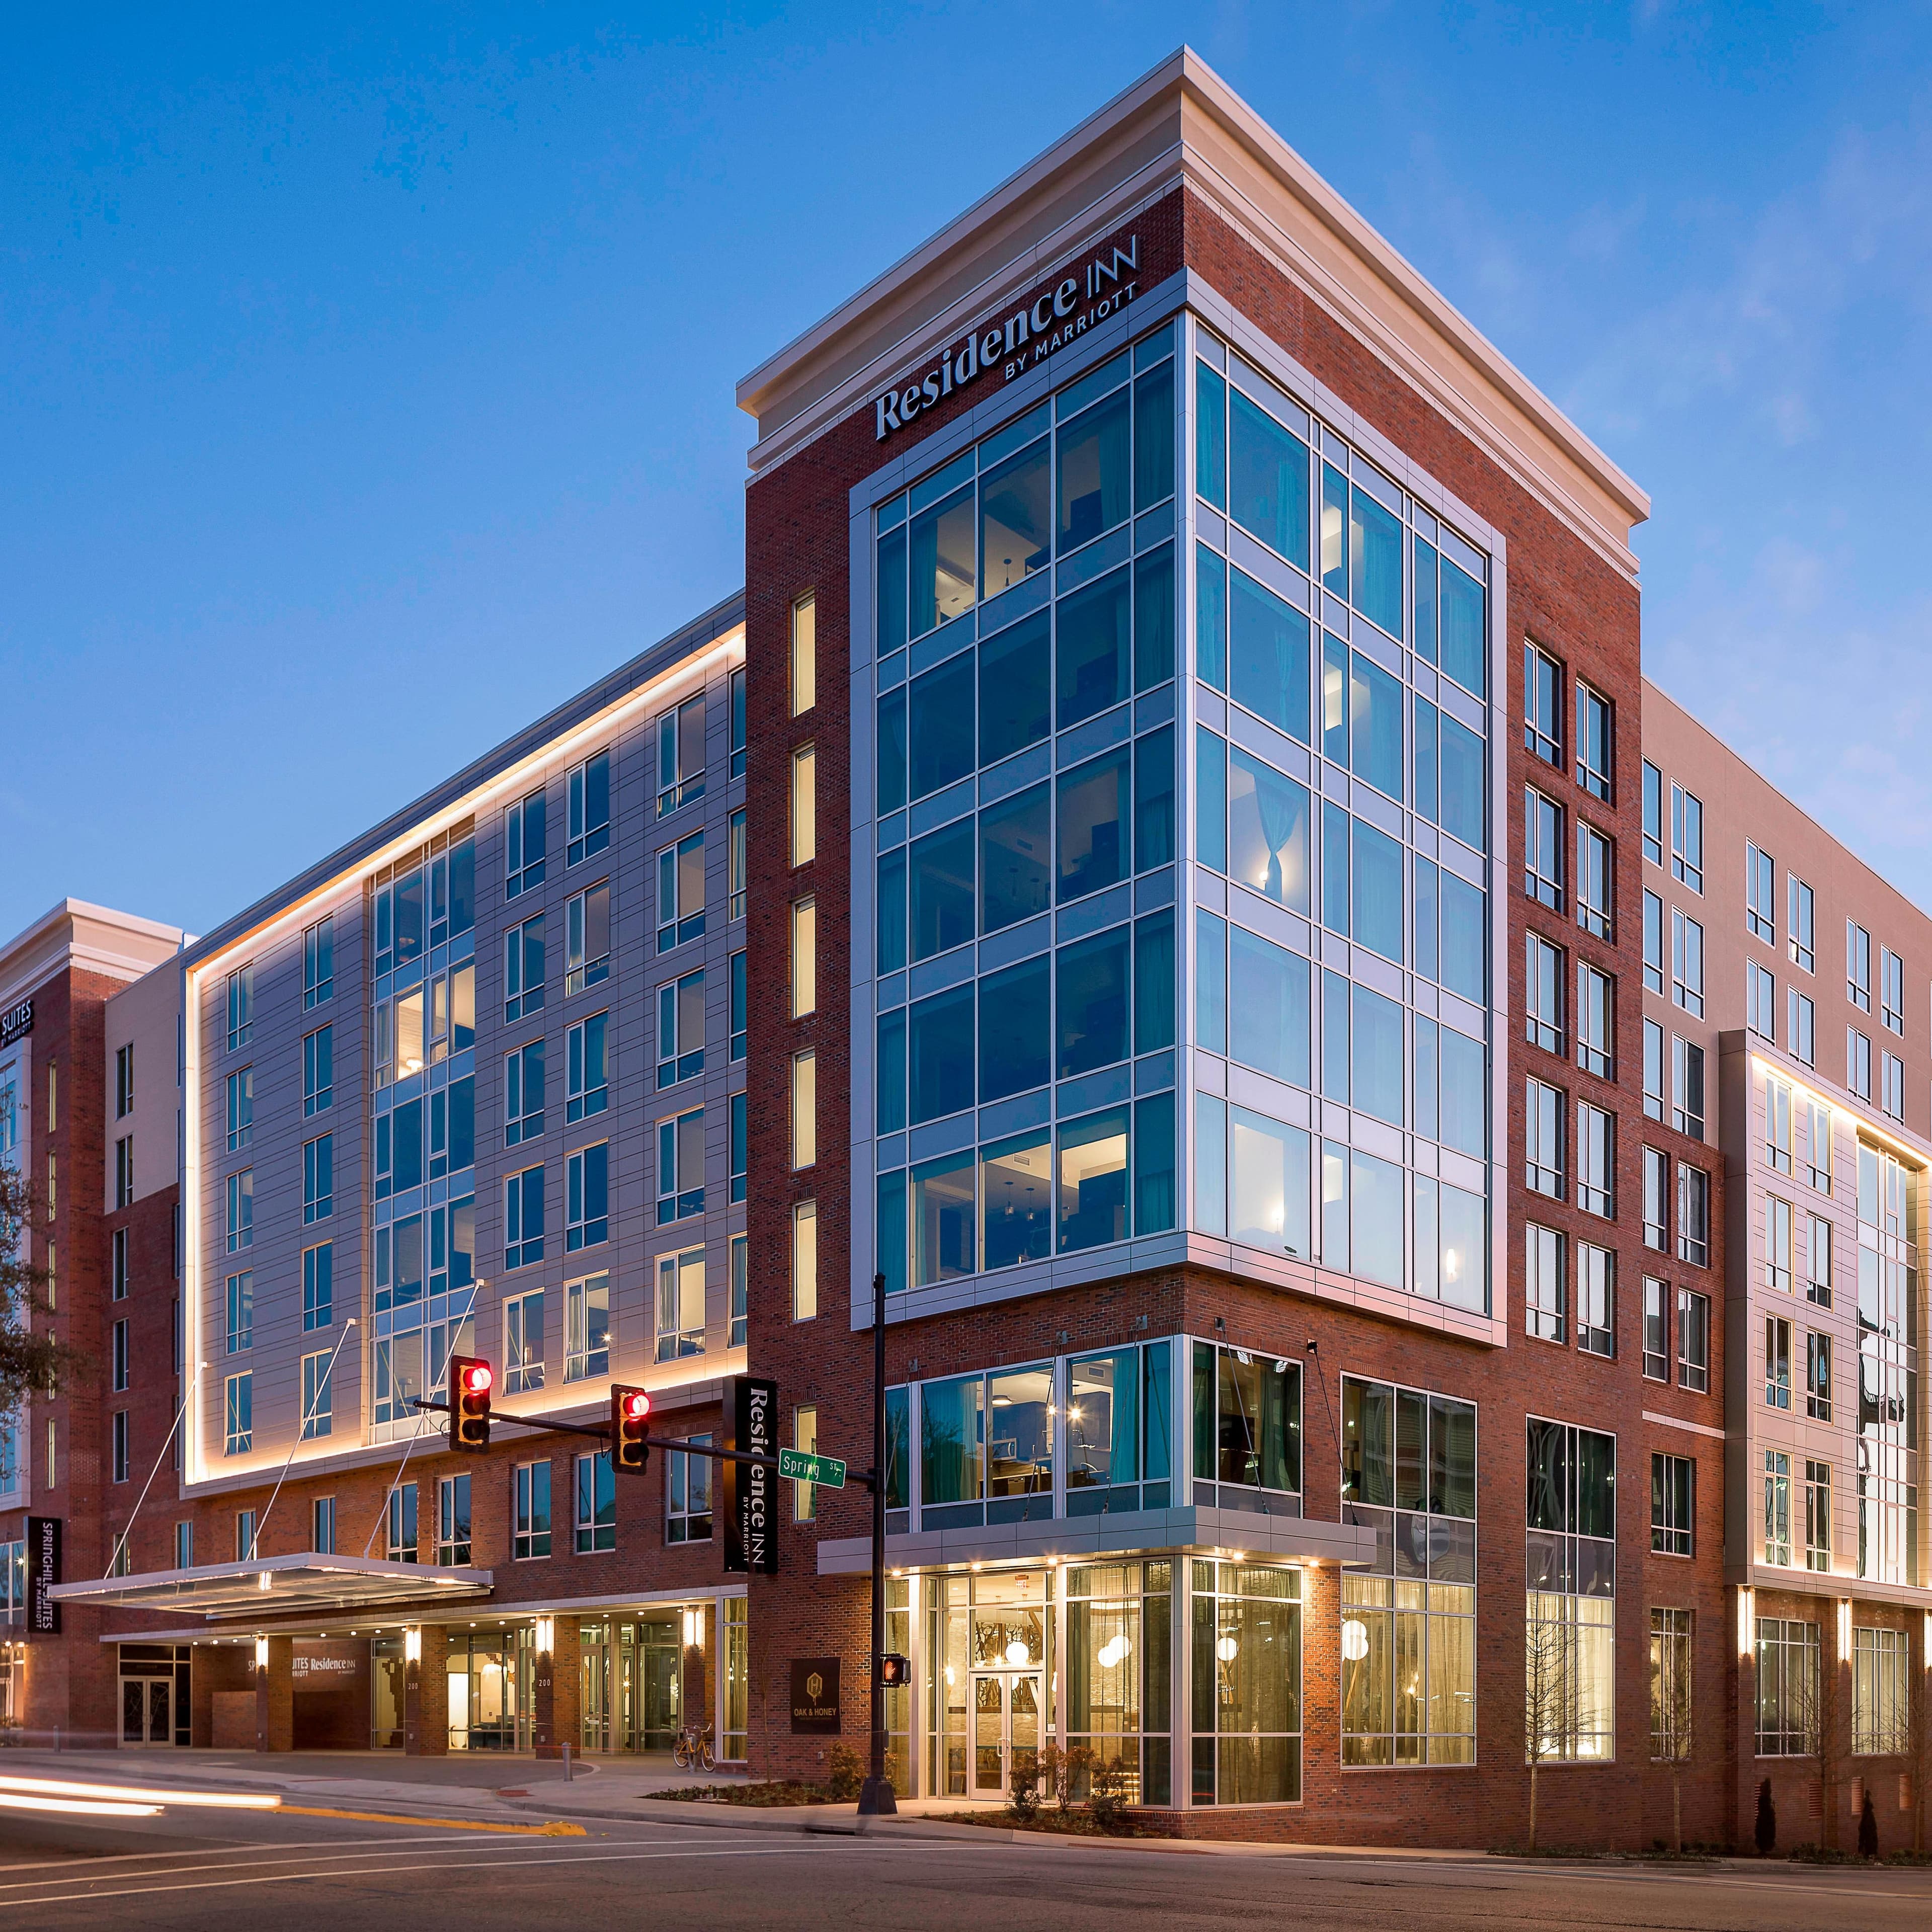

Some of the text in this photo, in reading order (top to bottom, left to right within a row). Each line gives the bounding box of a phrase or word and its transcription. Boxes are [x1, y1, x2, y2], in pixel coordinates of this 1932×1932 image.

[876, 234, 1141, 441] Residence INN
[1006, 281, 1140, 380] BY MARRIOTT
[2, 999, 31, 1035] SUITES
[783, 1456, 820, 1480] Spring
[743, 1497, 749, 1509] BY
[43, 1522, 52, 1588] SPRINGHILL
[752, 1533, 765, 1564] INN
[36, 1577, 41, 1587] BY
[311, 1657, 346, 1670] Residence
[347, 1659, 355, 1669] INN
[794, 1708, 836, 1716] OAK & HONEY
